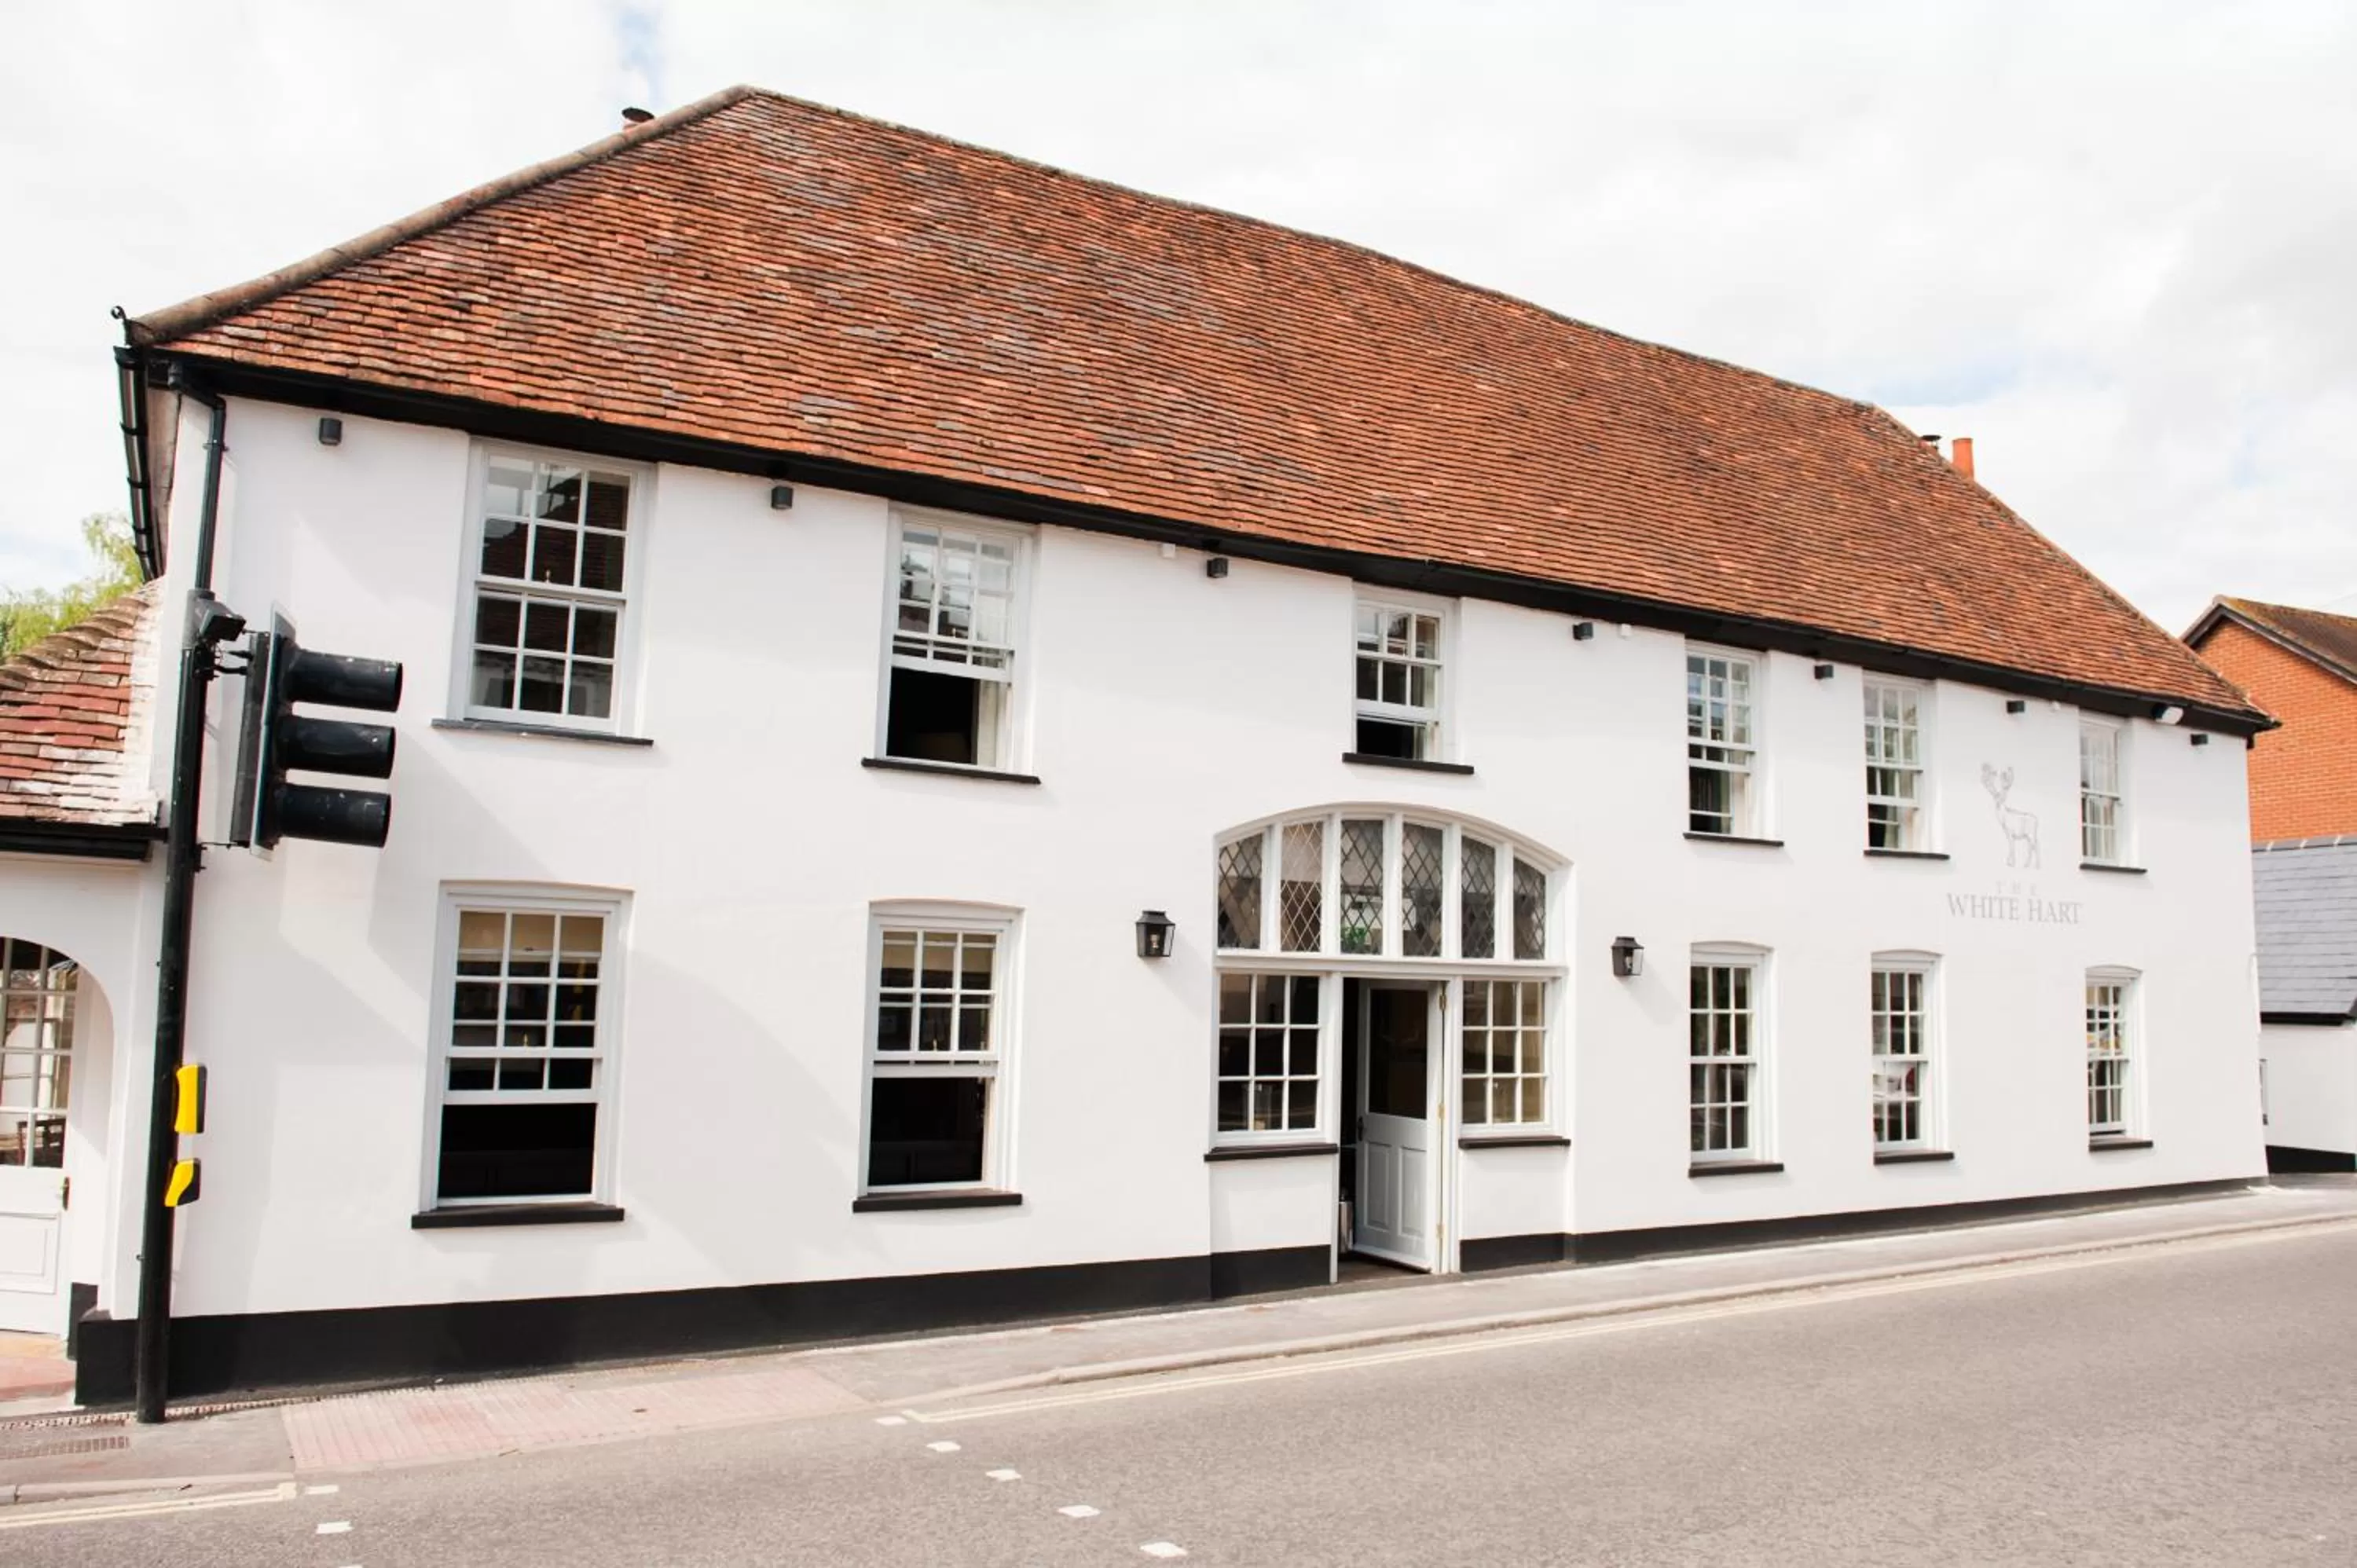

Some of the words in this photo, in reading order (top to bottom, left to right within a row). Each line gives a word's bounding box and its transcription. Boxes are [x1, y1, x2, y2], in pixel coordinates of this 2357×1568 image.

[1996, 880, 2037, 896] THE
[1947, 892, 2019, 921] WHITE
[2027, 899, 2084, 924] HART
